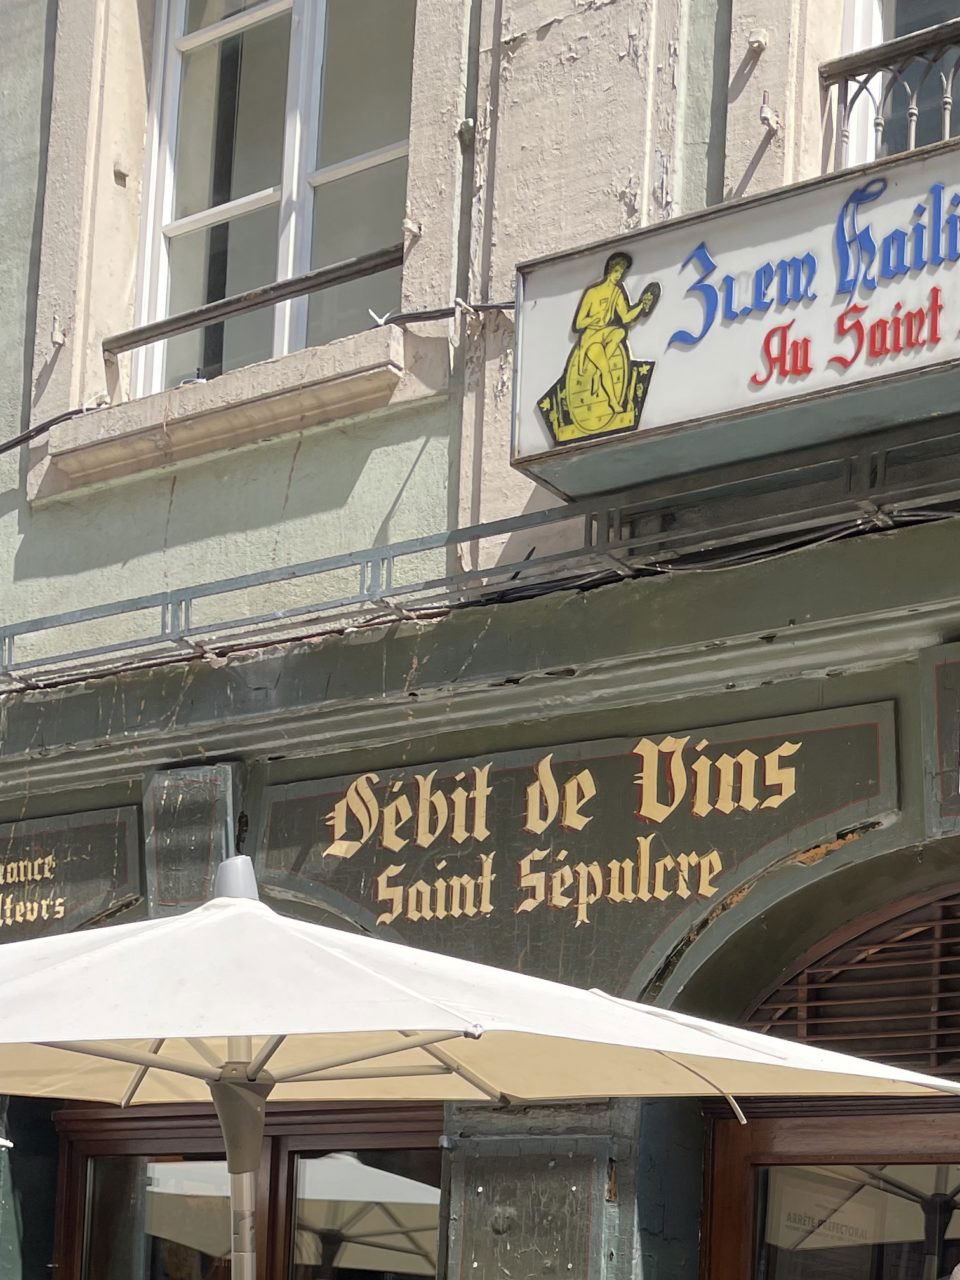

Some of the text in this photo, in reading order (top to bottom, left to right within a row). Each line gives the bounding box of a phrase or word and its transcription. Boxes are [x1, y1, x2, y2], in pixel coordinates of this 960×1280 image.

[749, 319, 813, 387] Au
[828, 286, 943, 368] Saint
[323, 736, 802, 859] Débit de Vins
[376, 833, 723, 928] Saint Sépulcre
